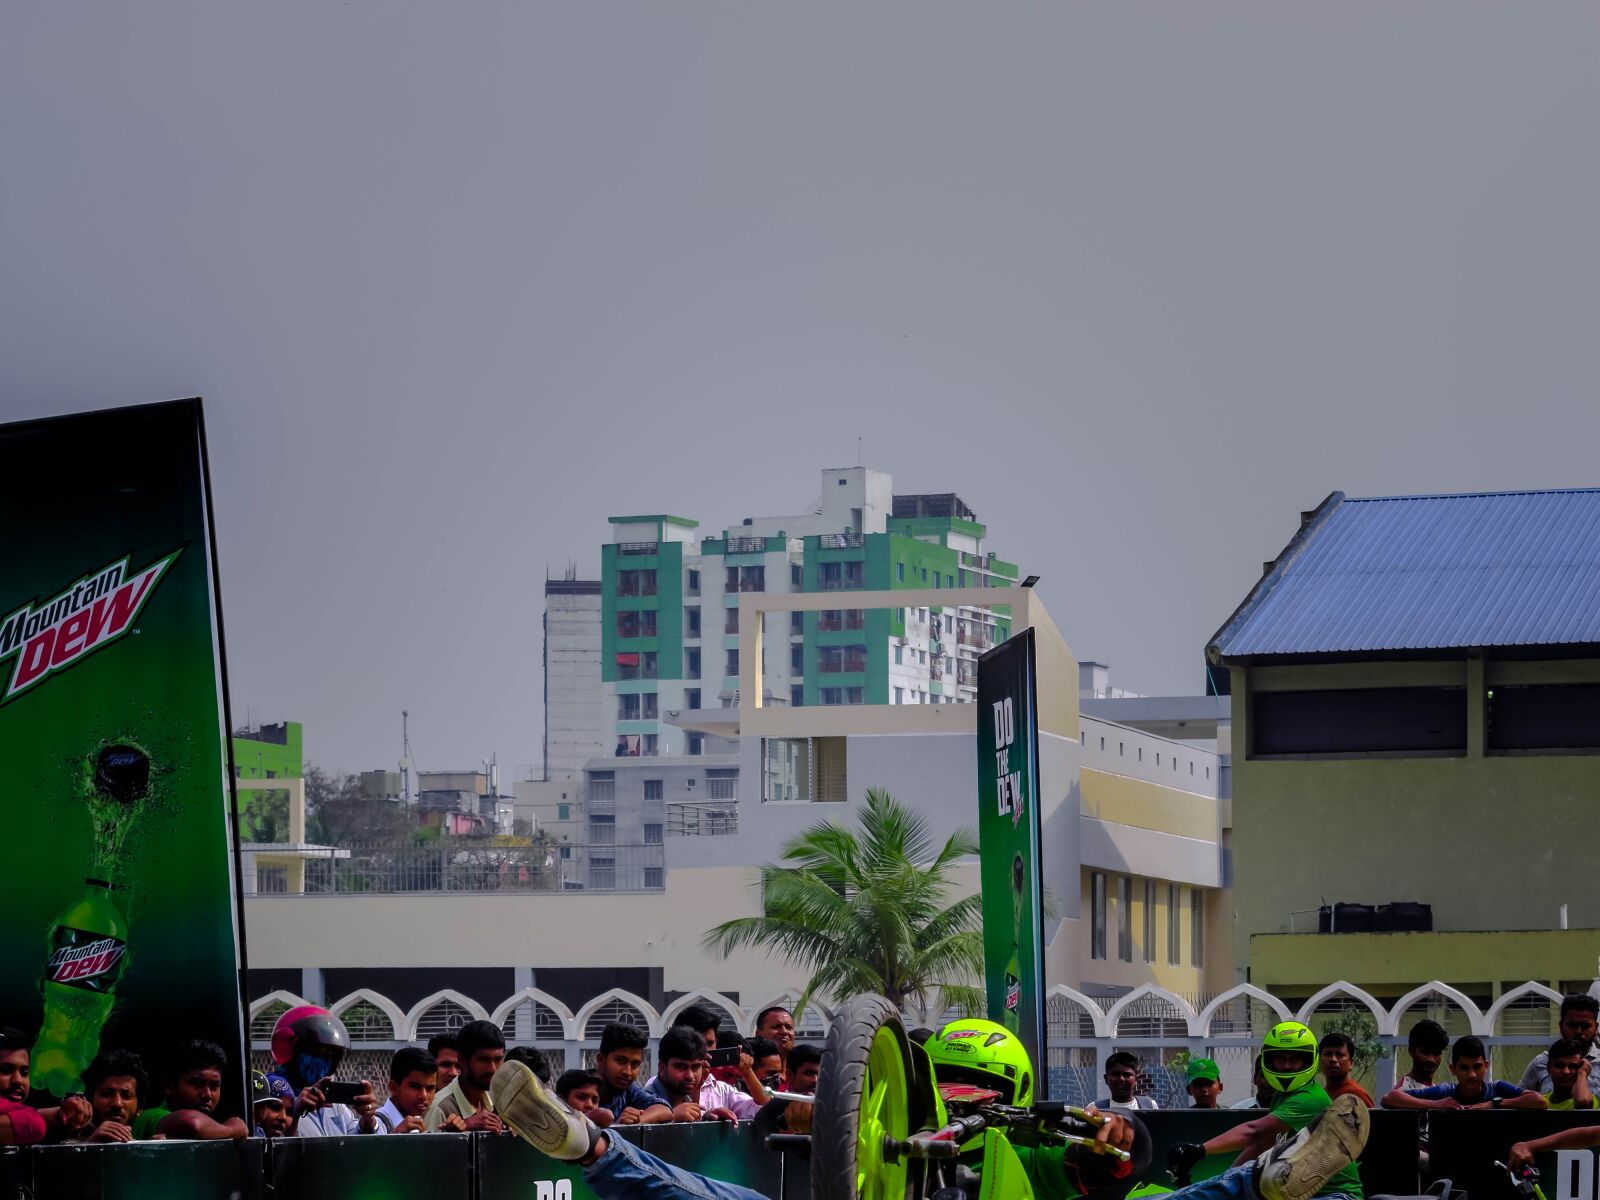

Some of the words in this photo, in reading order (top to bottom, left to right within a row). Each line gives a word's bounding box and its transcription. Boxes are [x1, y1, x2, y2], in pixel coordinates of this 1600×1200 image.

[0, 565, 123, 655] Mountain
[992, 697, 1014, 750] DO
[996, 748, 1009, 777] THE
[996, 770, 1021, 816] DEW
